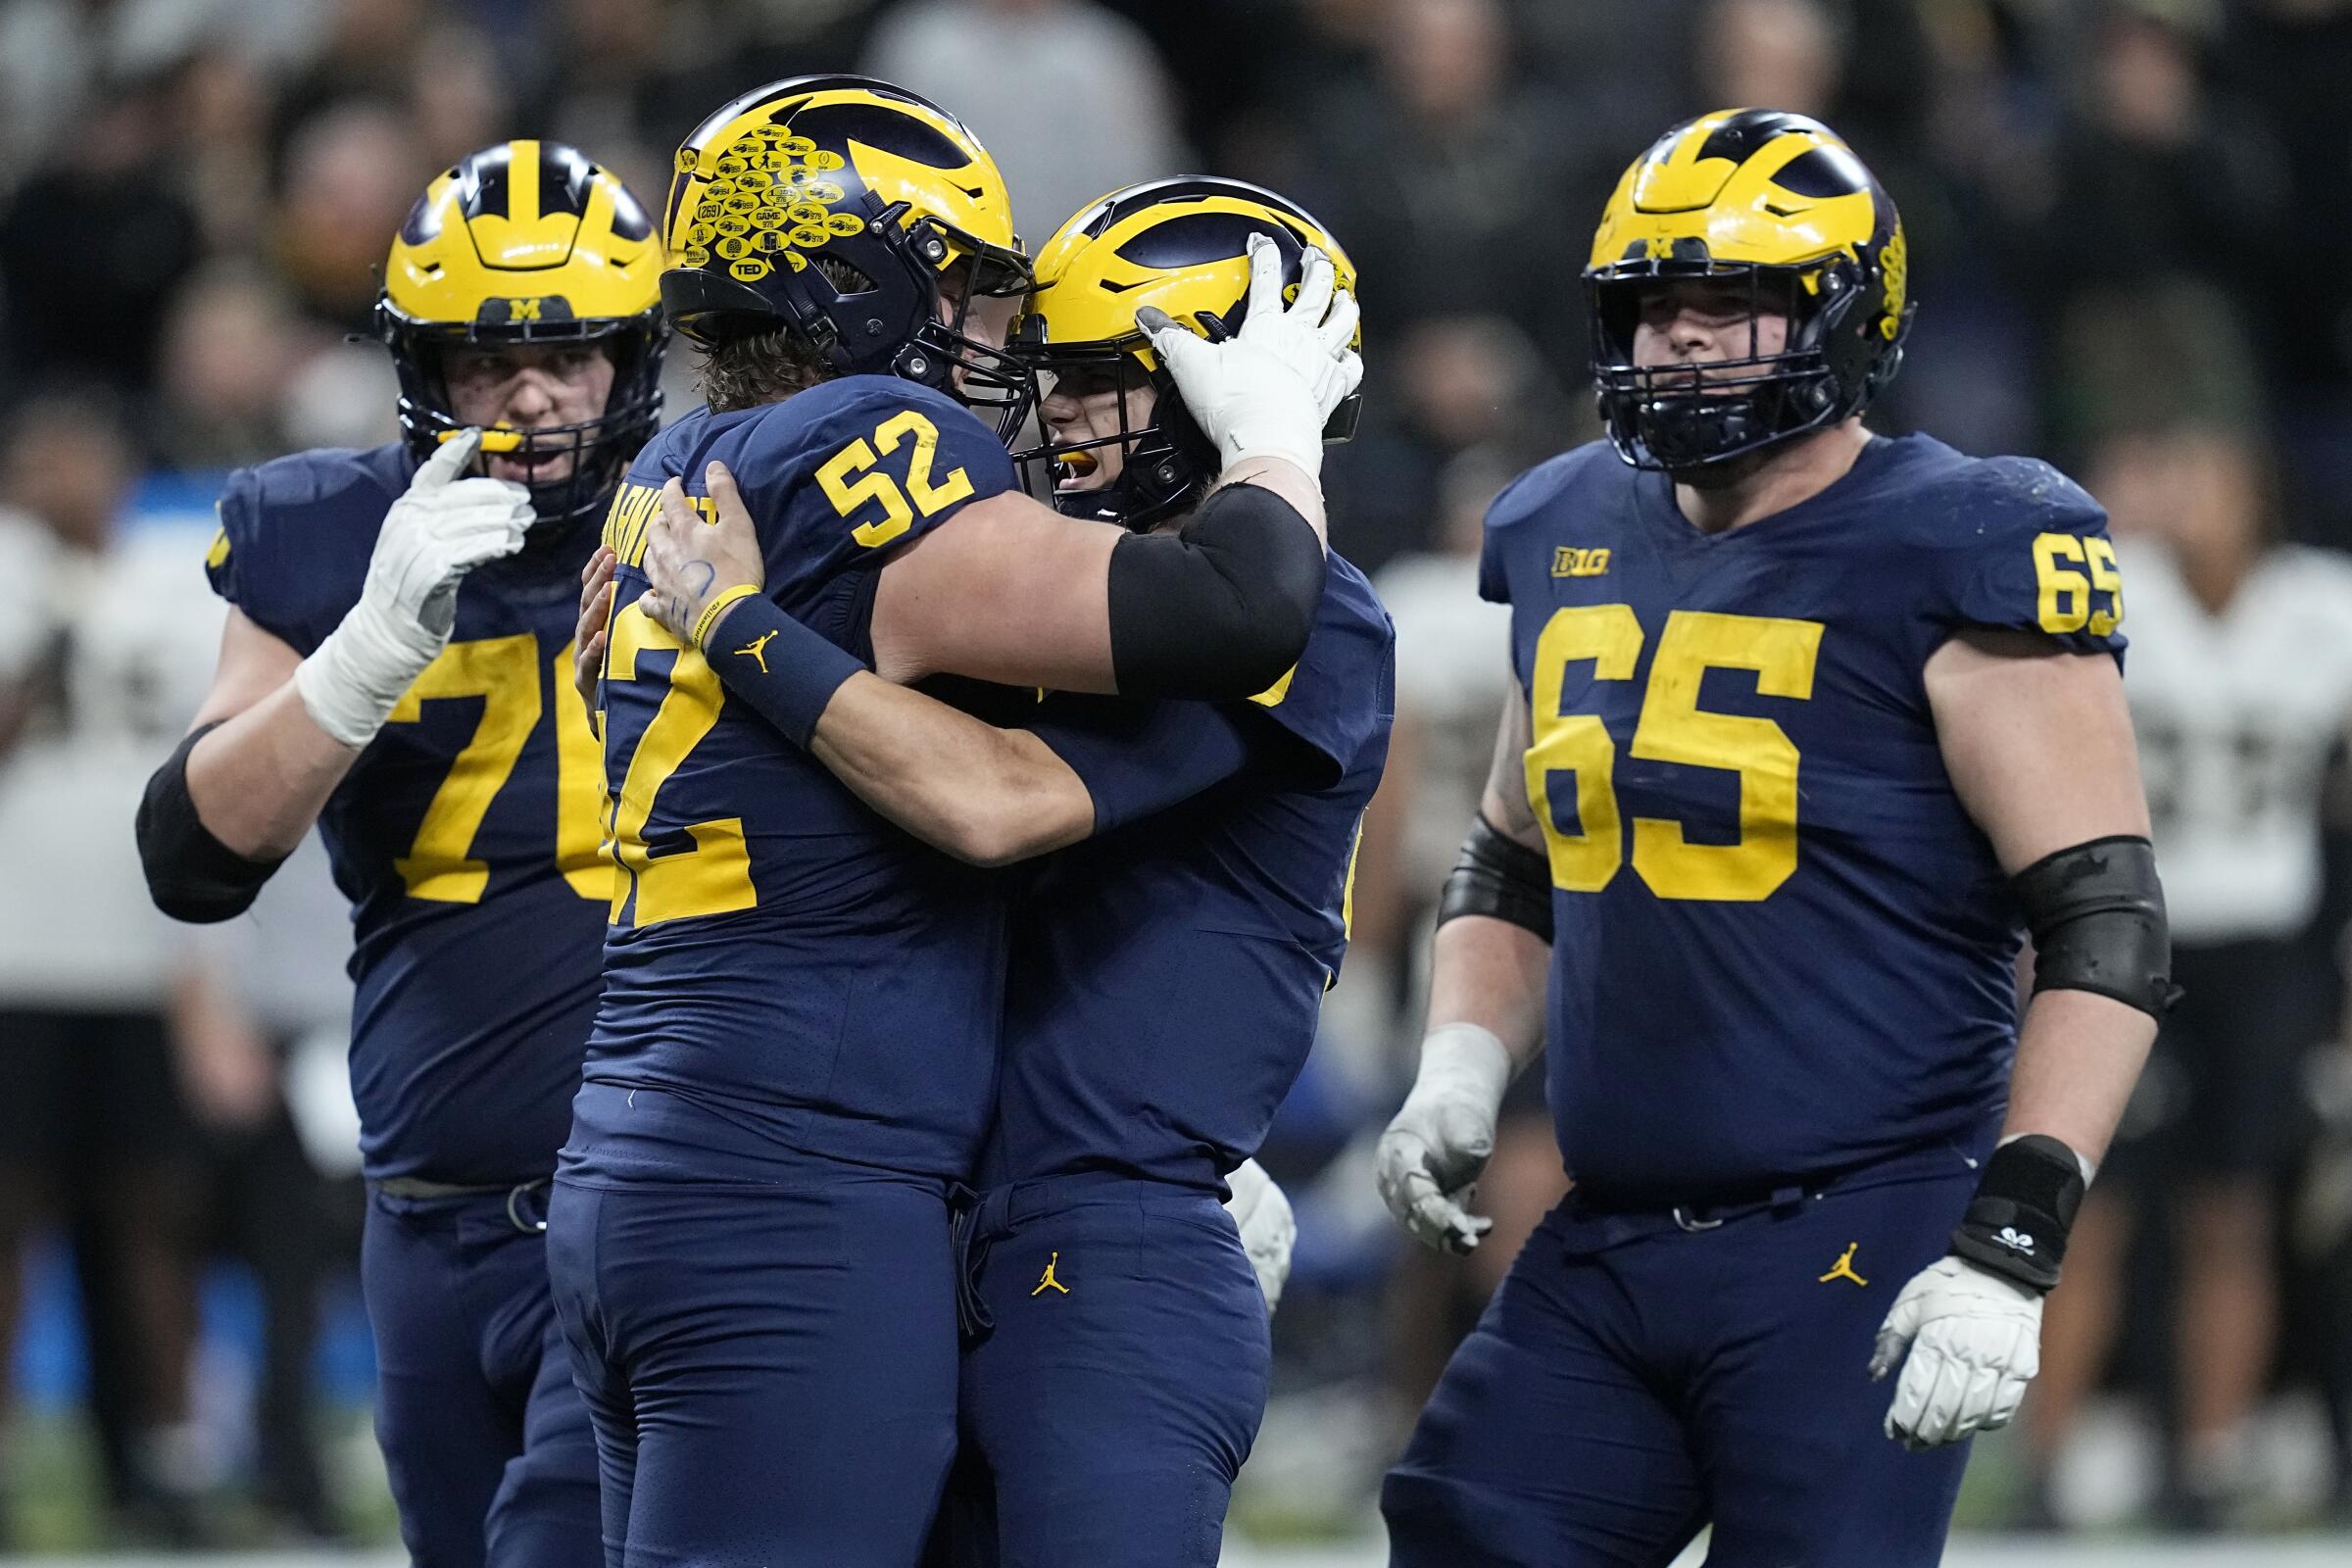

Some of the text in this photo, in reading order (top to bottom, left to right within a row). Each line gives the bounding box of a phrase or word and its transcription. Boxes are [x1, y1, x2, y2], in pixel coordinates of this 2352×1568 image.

[697, 204, 721, 220] (269)
[756, 212, 781, 220] GAME
[809, 212, 822, 220] 979
[845, 223, 858, 232] 985
[735, 264, 761, 275] TED
[509, 298, 541, 320] M
[814, 410, 975, 548] 52
[2033, 533, 2125, 637] 65
[1524, 604, 1825, 902] 65
